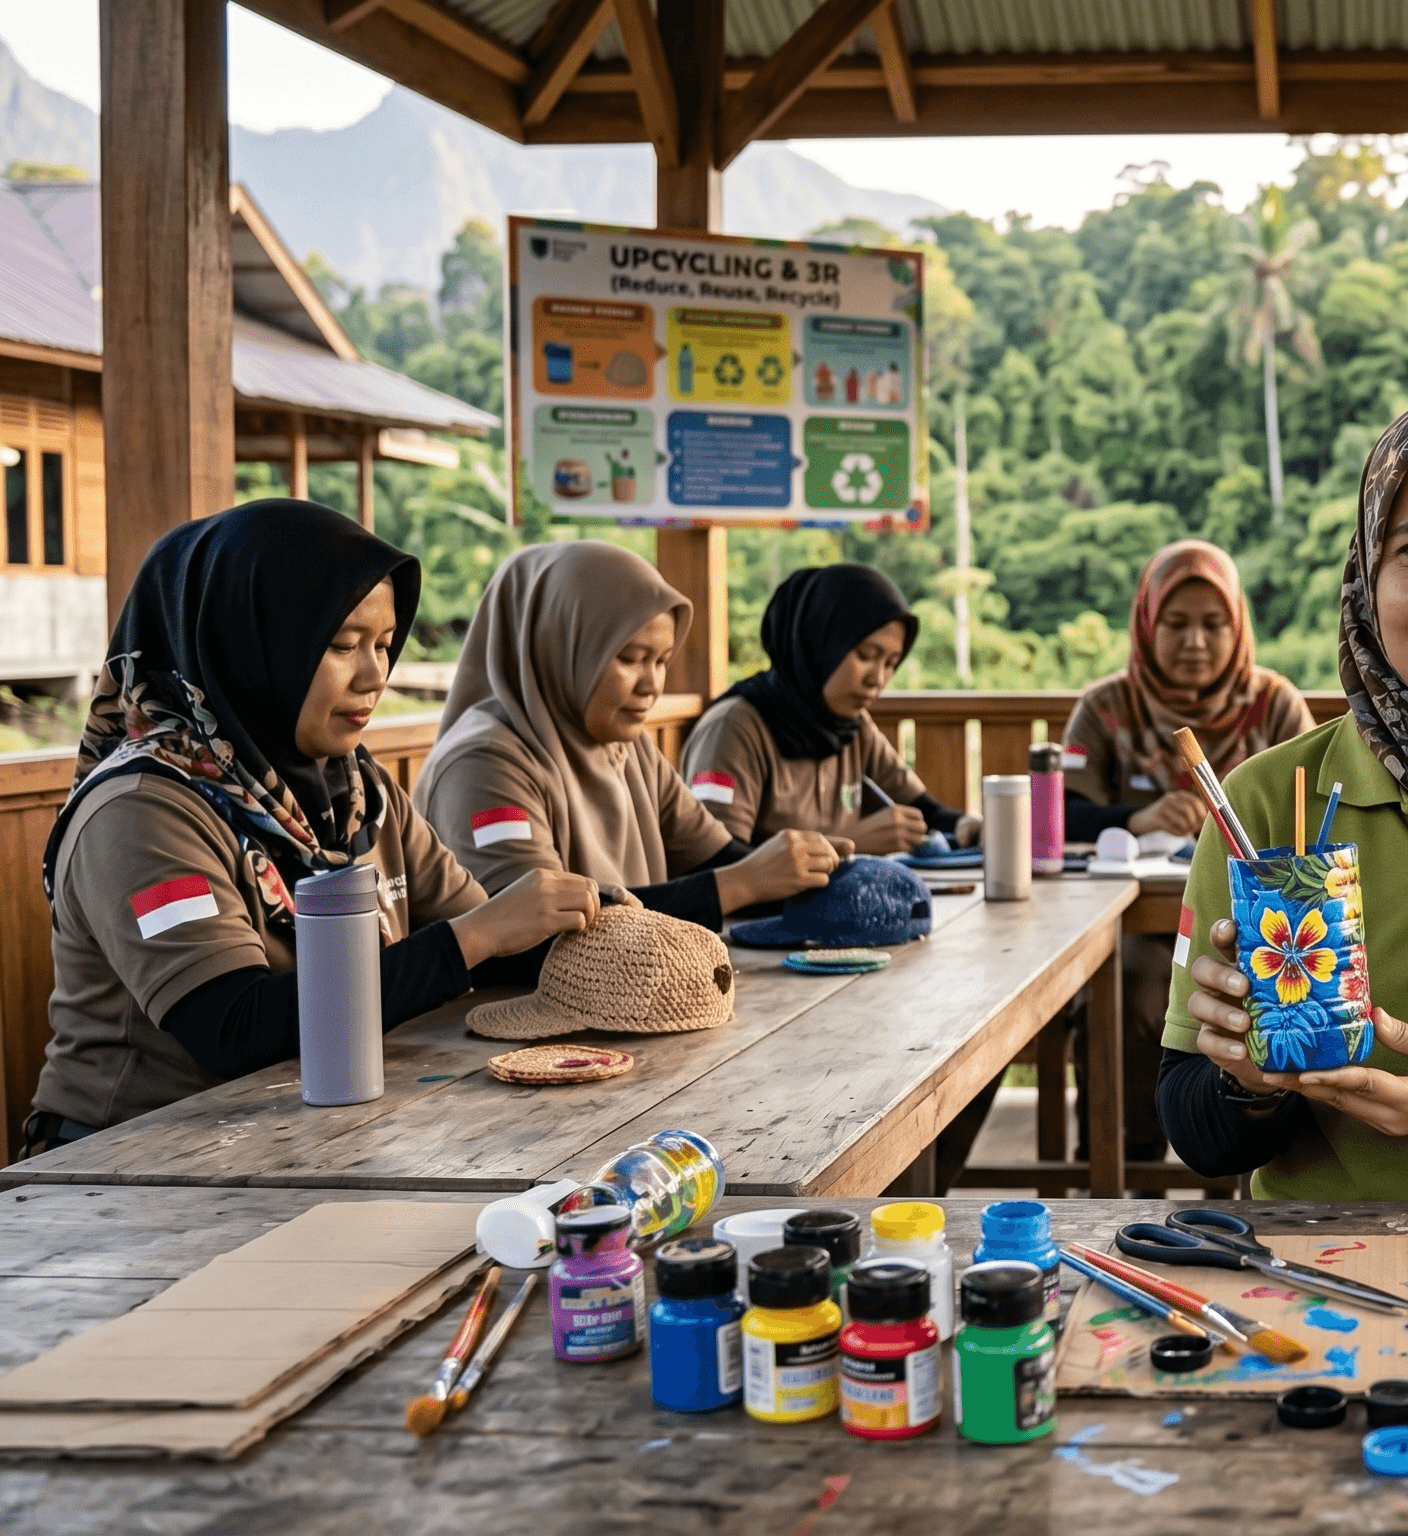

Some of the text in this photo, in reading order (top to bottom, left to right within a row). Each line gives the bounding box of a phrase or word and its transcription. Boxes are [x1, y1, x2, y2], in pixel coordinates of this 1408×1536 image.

[610, 245, 772, 280] UPCYCLING
[781, 259, 798, 281] &
[806, 261, 839, 284] 3R
[611, 275, 695, 298] (Reduce,
[700, 281, 761, 303] Reuse,
